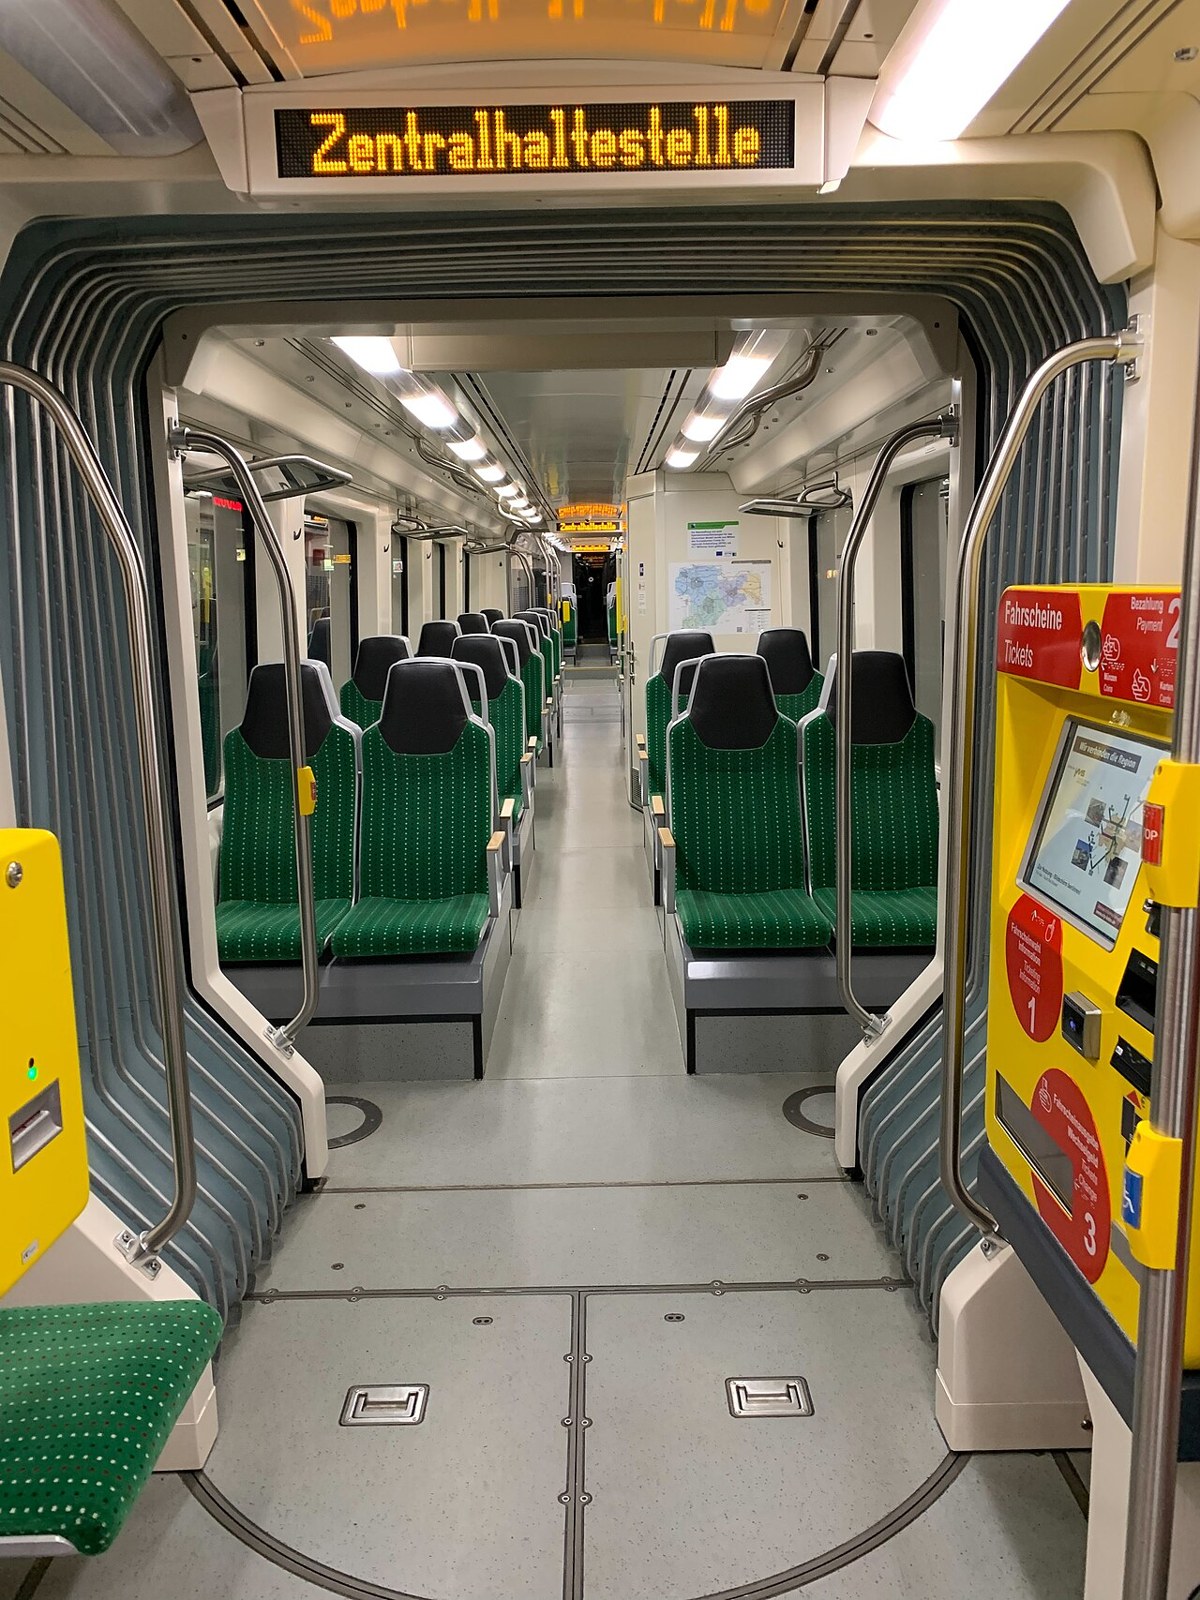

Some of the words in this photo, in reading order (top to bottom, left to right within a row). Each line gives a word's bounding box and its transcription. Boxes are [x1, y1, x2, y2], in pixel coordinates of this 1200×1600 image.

[310, 104, 761, 175] Zentralhaltestelle
[1005, 600, 1062, 630] Fahrscheine
[1130, 596, 1164, 614] Bezahlung
[1166, 597, 1180, 648] 2
[1136, 617, 1163, 634] Payment
[1004, 639, 1034, 668] Tickets
[1118, 754, 1137, 769] Region
[1144, 828, 1158, 842] OP
[1018, 940, 1041, 967] Information
[1019, 968, 1041, 995] Information
[1027, 996, 1036, 1034] 1
[1083, 1211, 1097, 1257] 3
